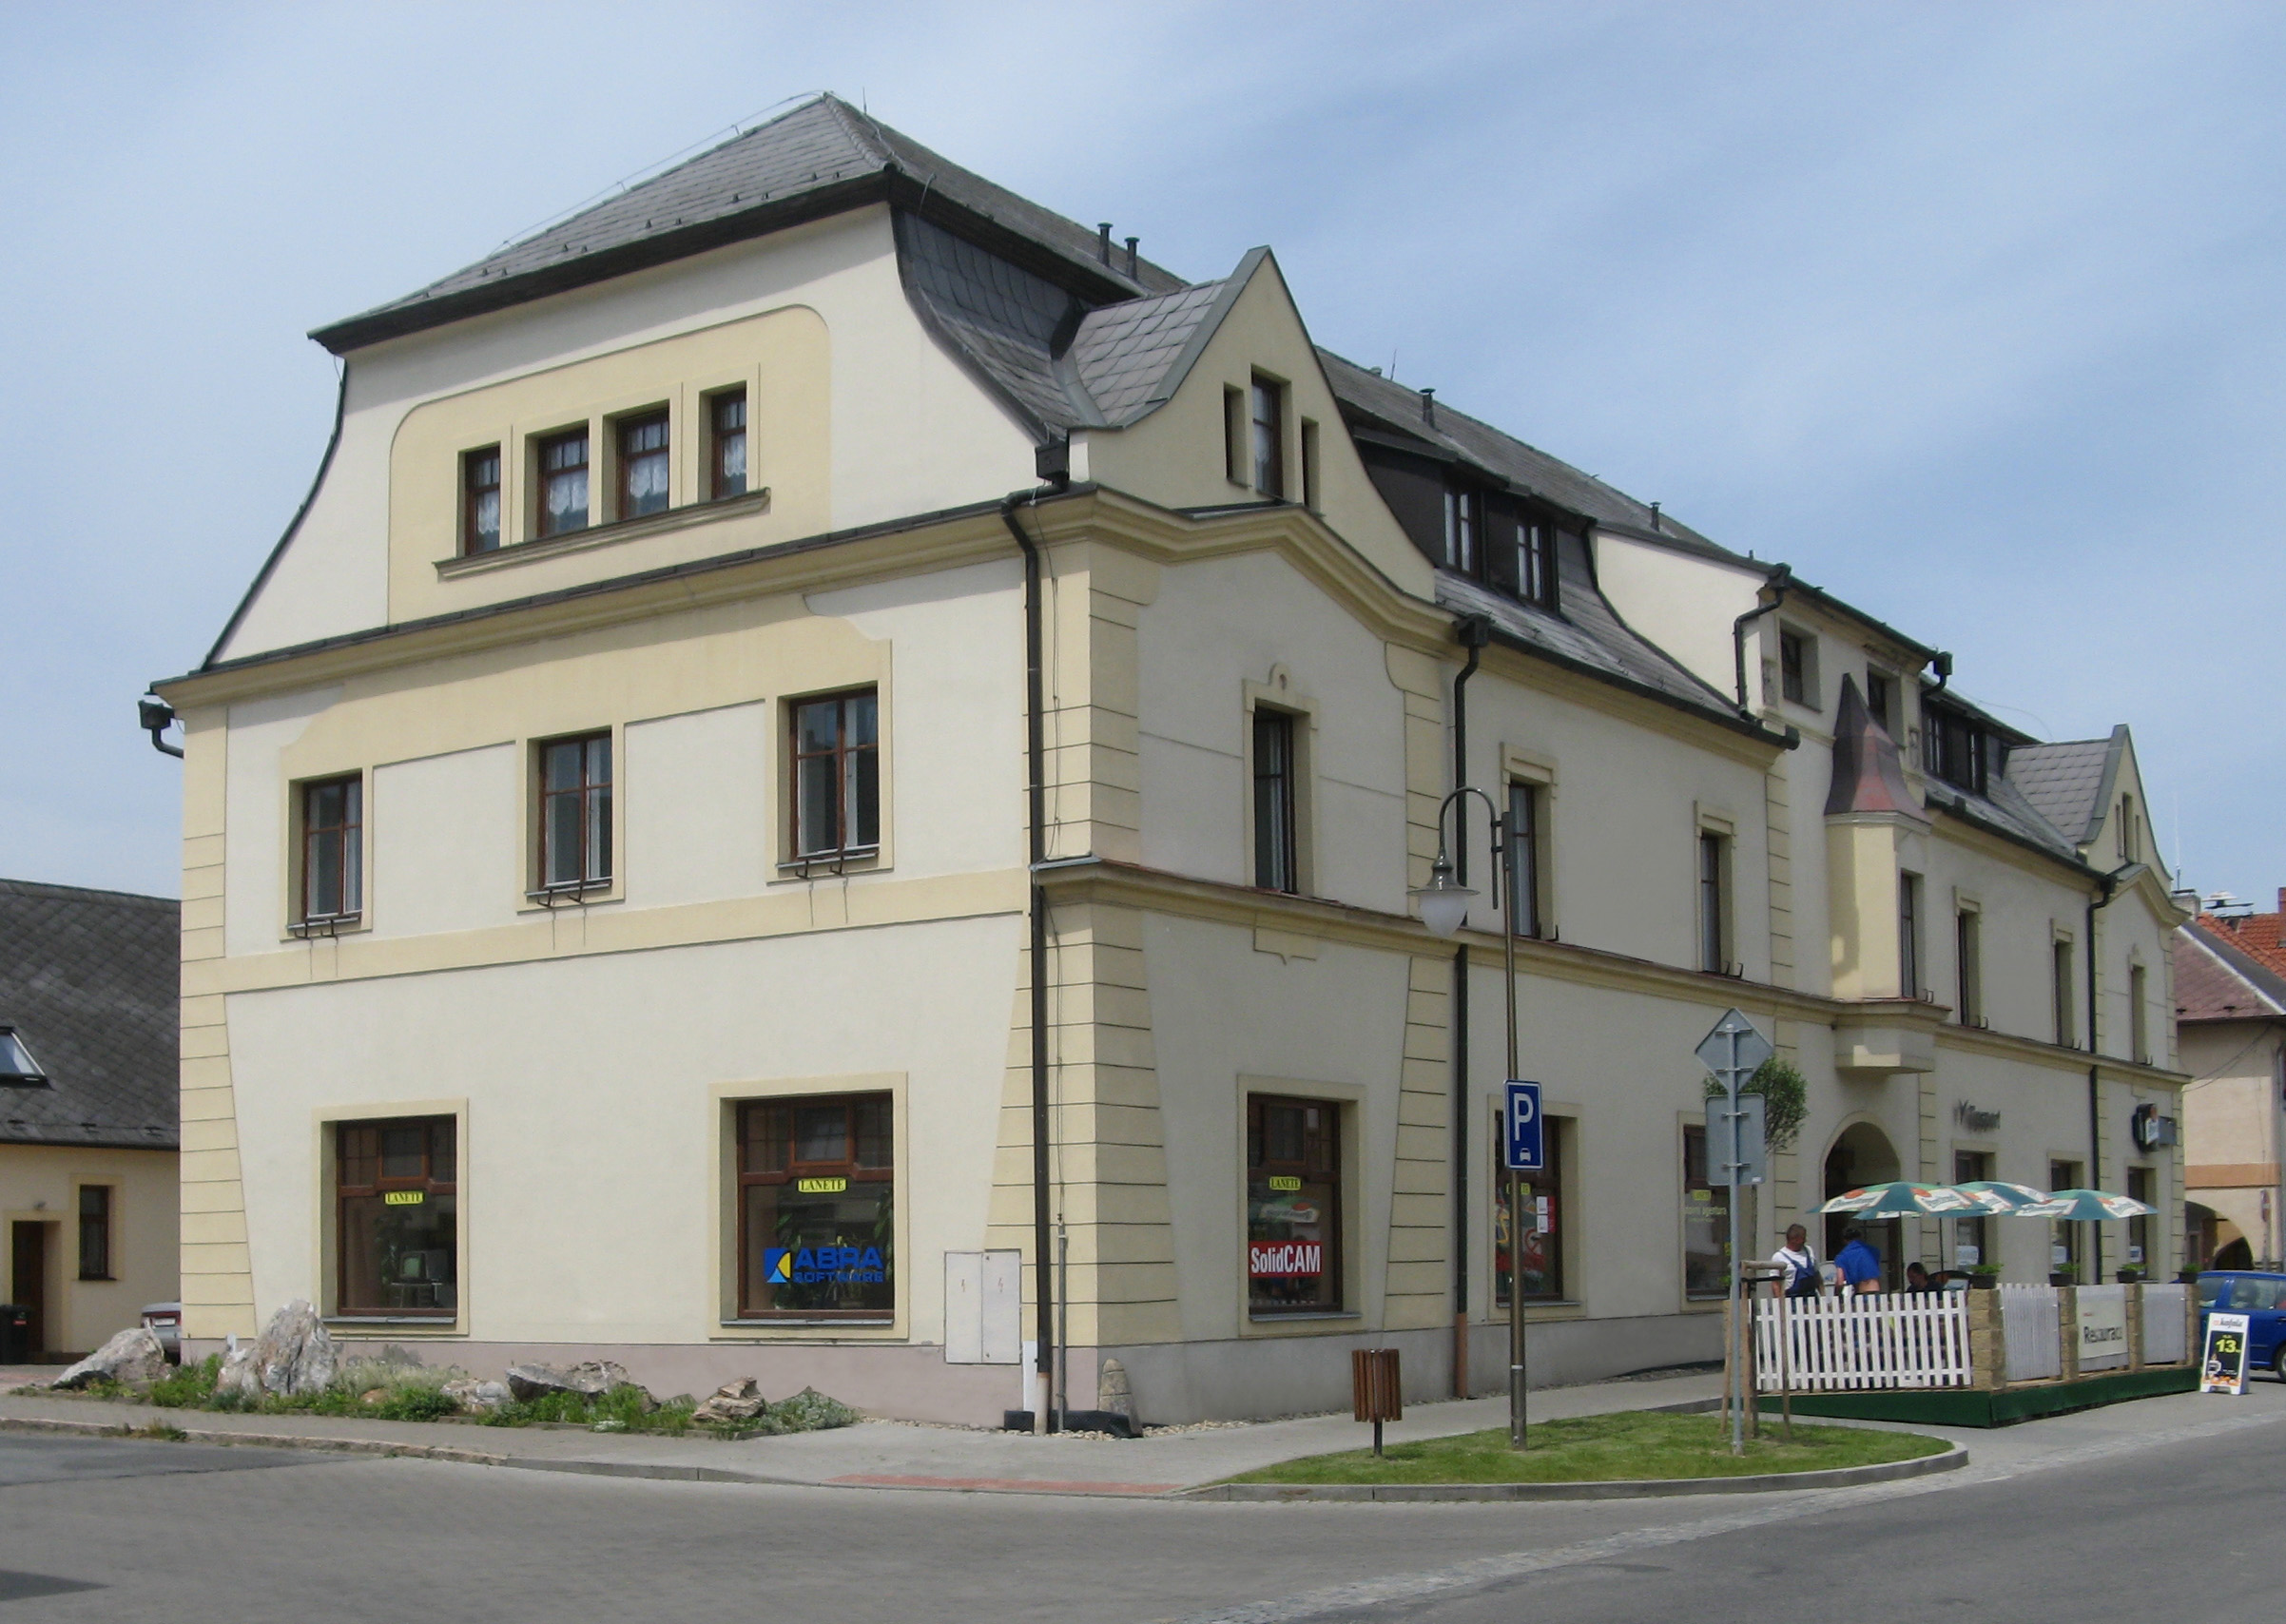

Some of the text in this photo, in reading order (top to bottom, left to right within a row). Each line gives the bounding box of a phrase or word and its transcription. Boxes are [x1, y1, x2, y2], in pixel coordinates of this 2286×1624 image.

[1514, 1092, 1534, 1141] P
[801, 1179, 843, 1190] LANETE
[794, 1247, 883, 1269] ABRA
[1251, 1245, 1320, 1273] SolidCAM
